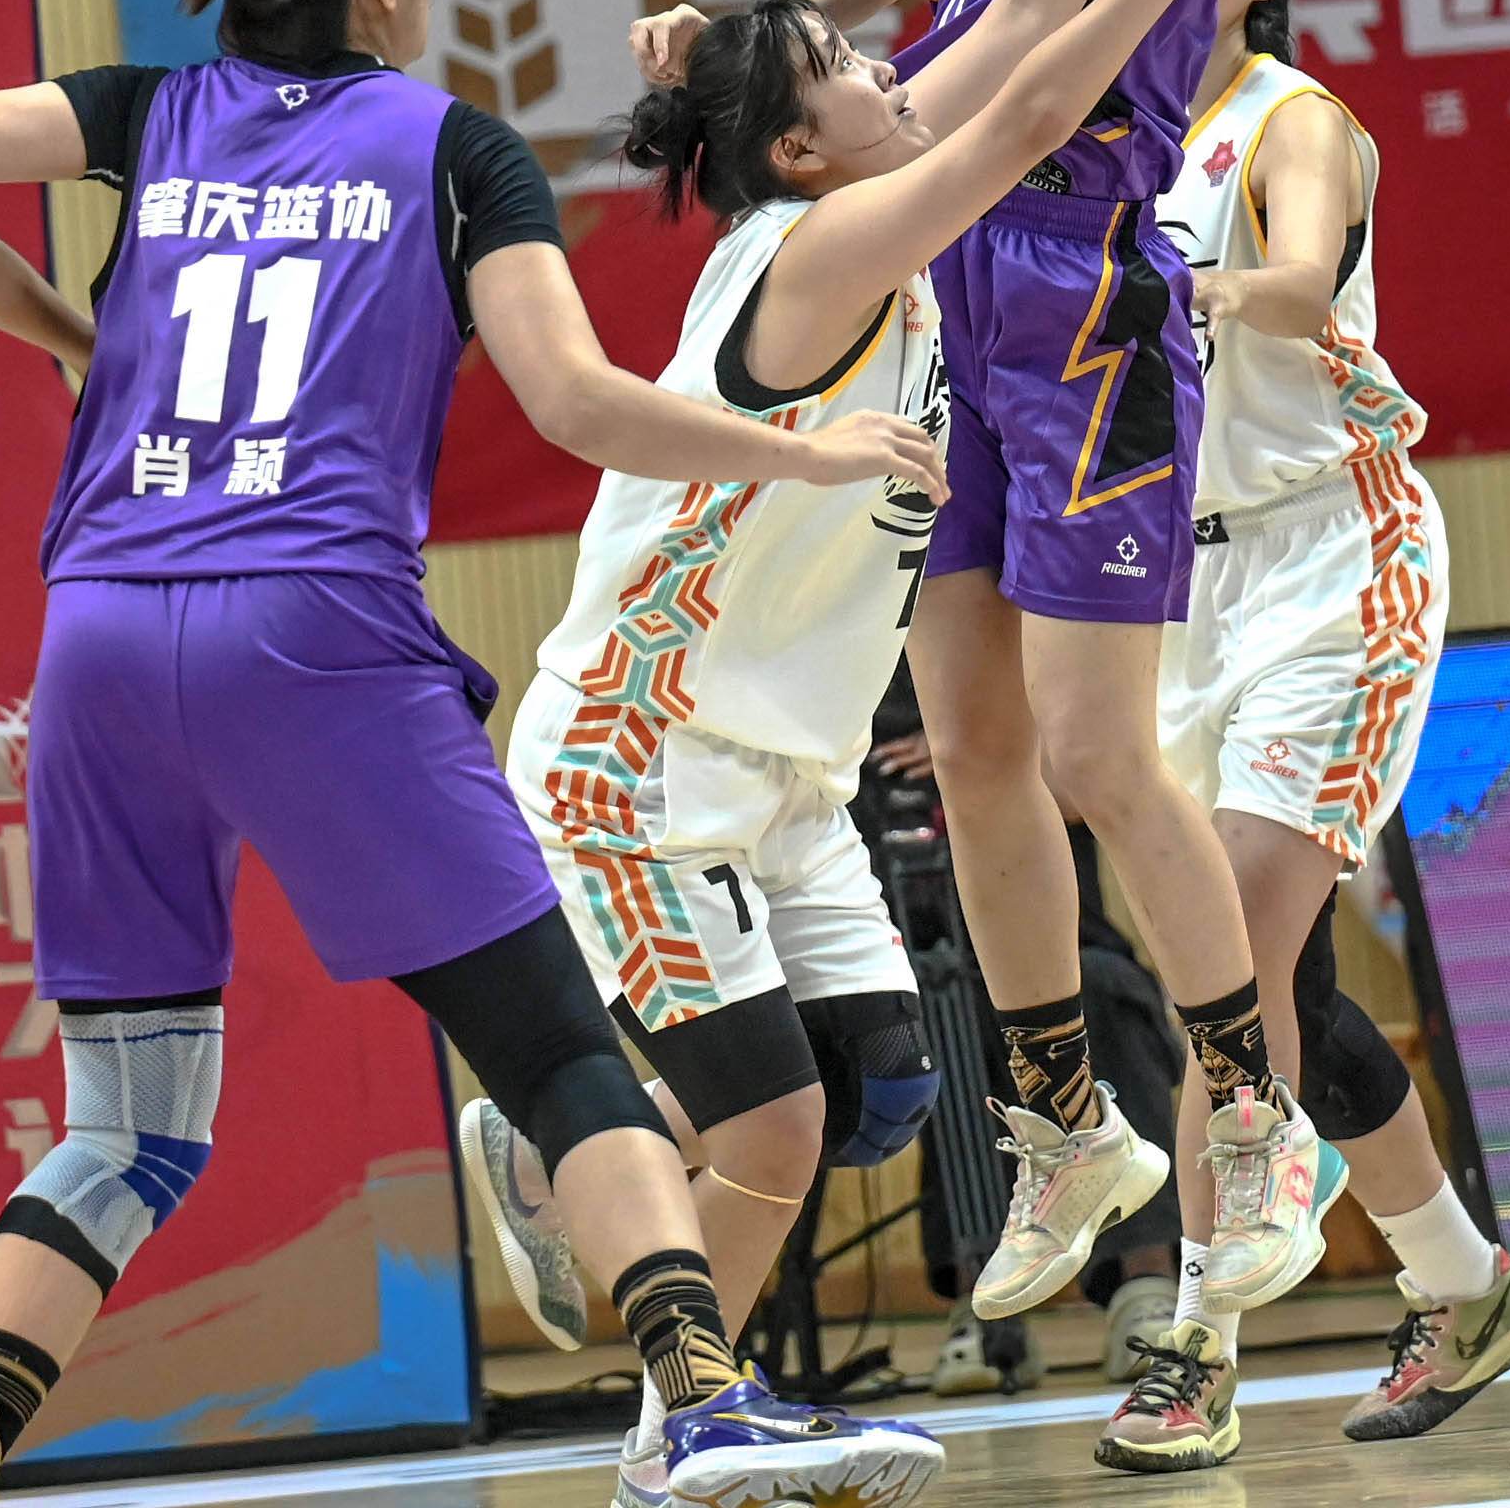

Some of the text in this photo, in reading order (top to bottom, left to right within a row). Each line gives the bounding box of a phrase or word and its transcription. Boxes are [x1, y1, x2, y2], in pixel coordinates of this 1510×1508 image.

[137, 178, 392, 243] 肇庆篮协
[170, 253, 323, 424] 11
[1100, 561, 1147, 579] RIGORER
[1250, 760, 1299, 779] RIGORER
[702, 863, 752, 935] 7
